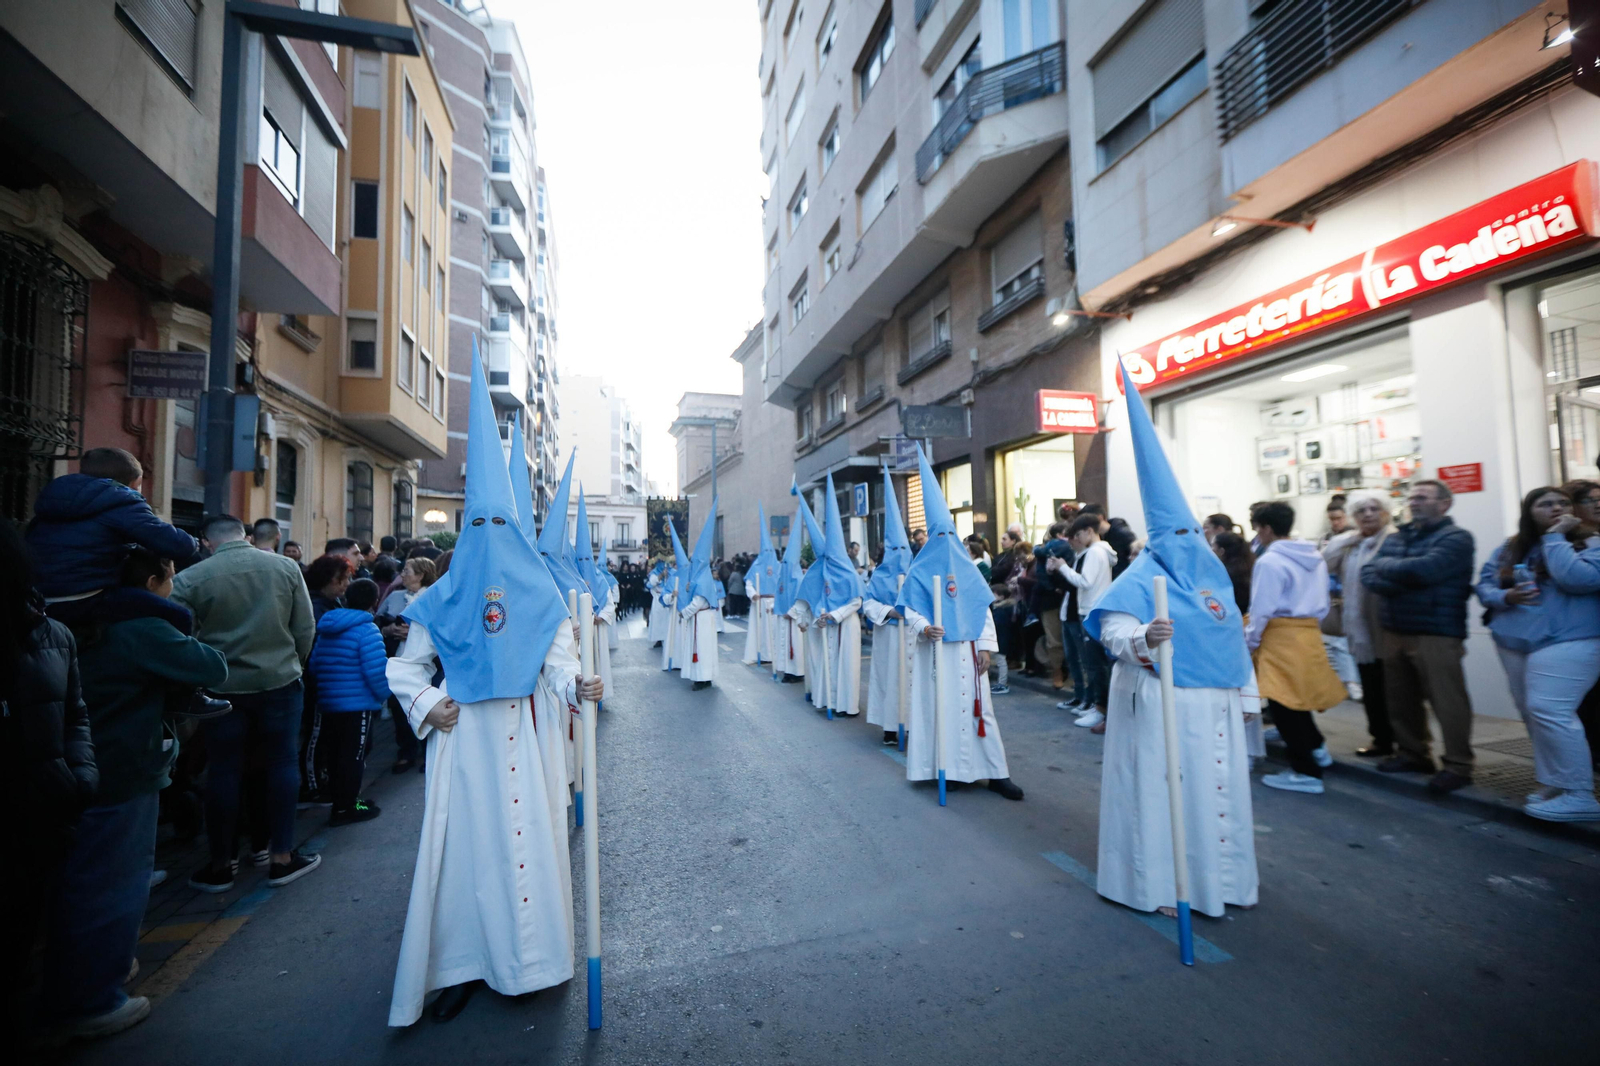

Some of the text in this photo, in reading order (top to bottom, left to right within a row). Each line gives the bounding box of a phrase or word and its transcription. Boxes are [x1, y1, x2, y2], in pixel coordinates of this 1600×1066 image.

[1372, 265, 1418, 300] La
[1419, 204, 1579, 282] Cadena
[132, 367, 168, 378] ALCALDE
